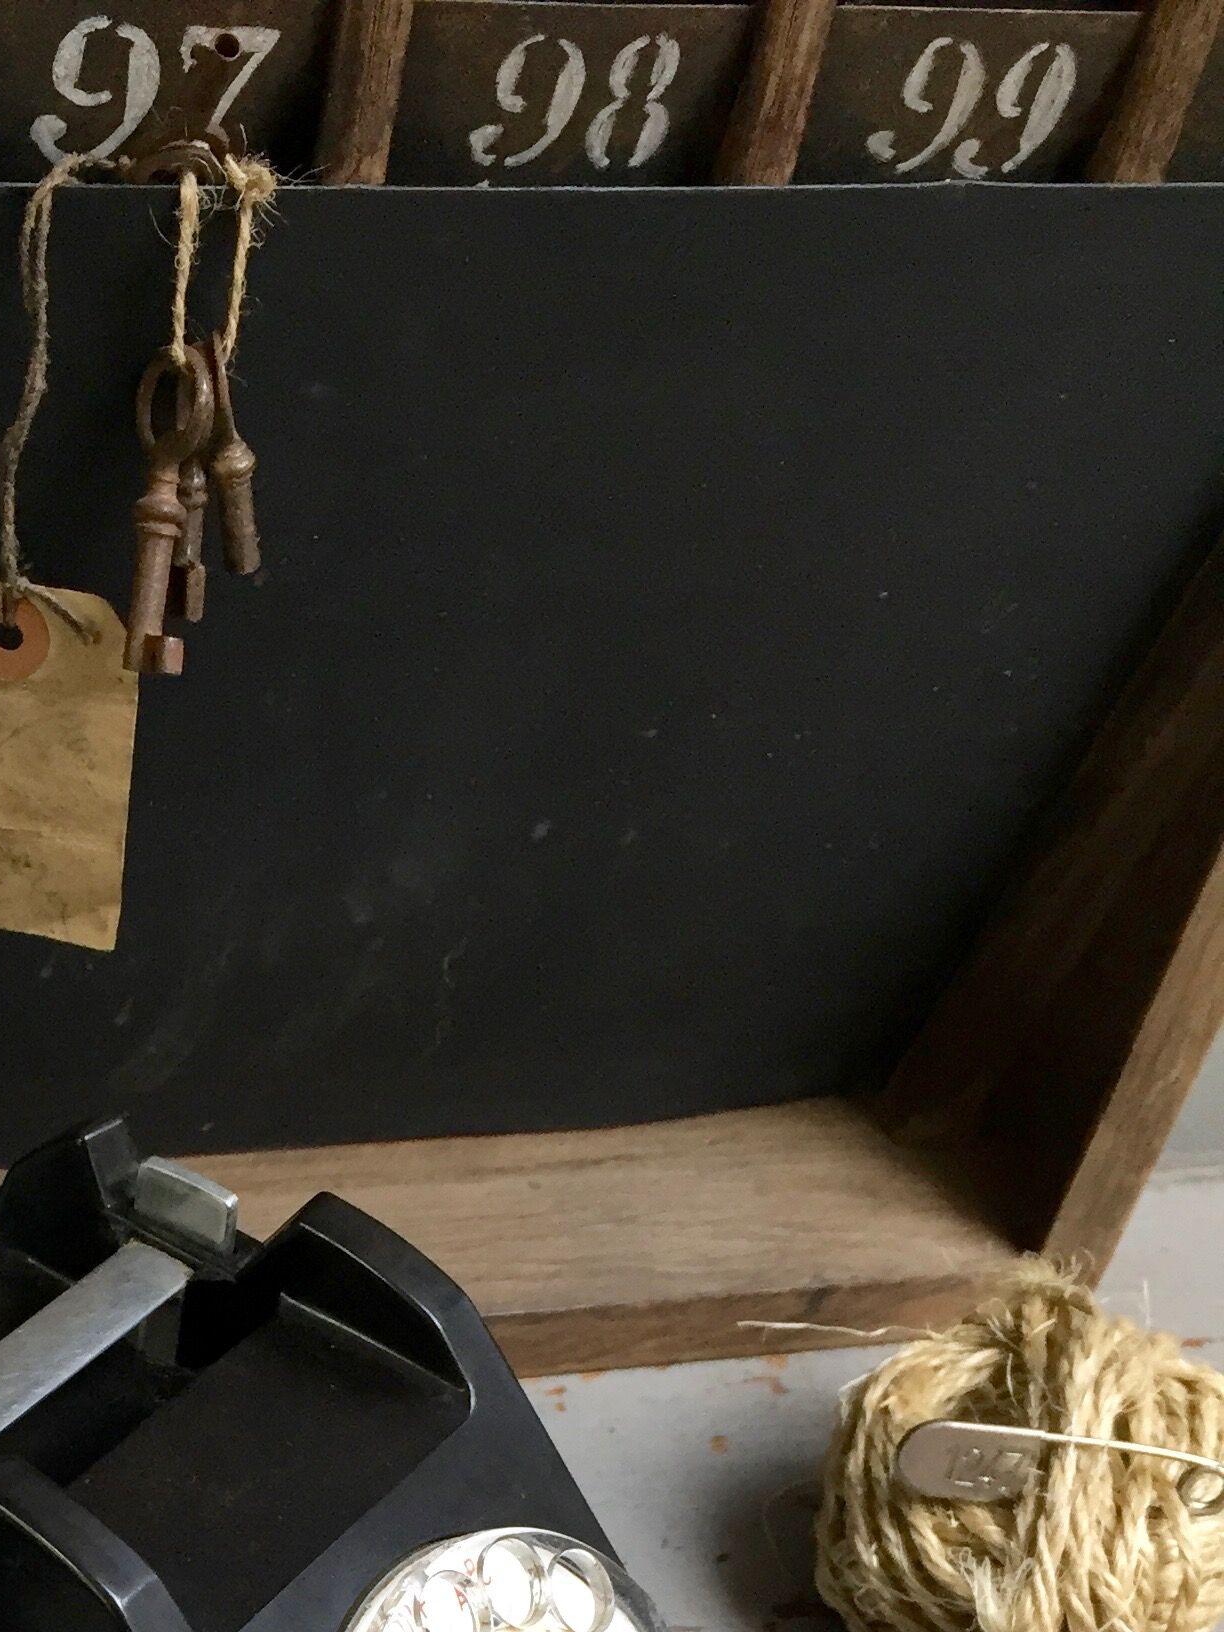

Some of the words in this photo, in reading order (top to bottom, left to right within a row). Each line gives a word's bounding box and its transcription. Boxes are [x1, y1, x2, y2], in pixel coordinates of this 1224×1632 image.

[30, 15, 281, 164] 97
[468, 32, 680, 168] 98
[865, 36, 1075, 180] 99
